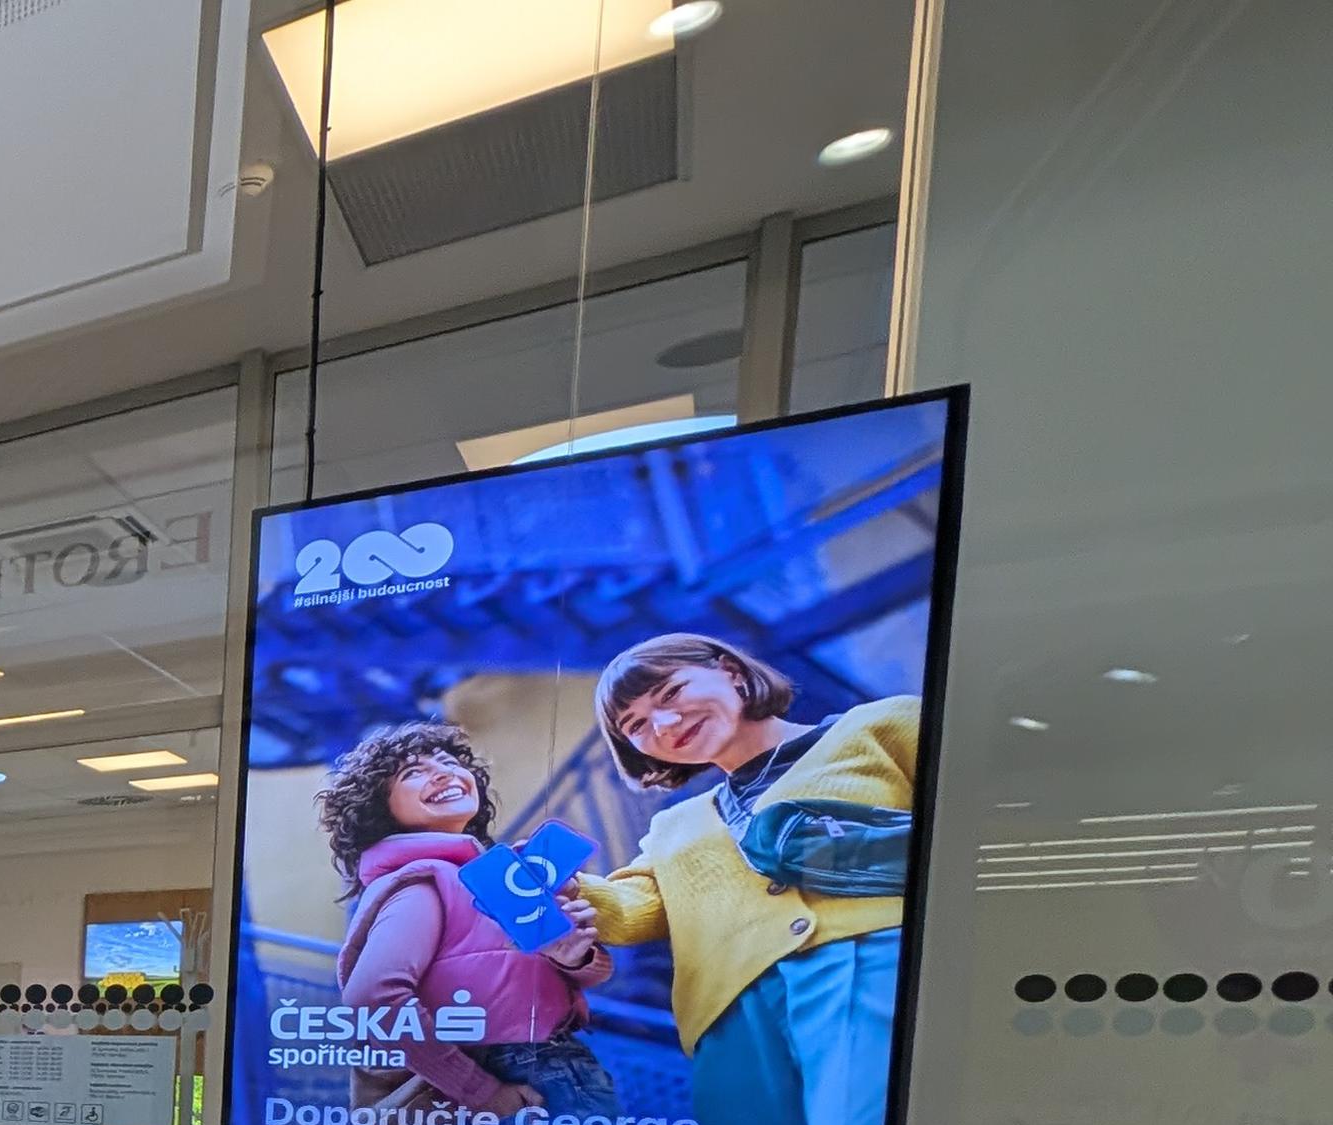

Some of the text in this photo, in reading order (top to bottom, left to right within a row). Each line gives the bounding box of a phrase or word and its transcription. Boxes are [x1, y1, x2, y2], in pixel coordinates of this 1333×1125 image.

[294, 576, 451, 608] #silnější budoucnost
[270, 998, 425, 1042] ČESKÁ
[268, 1045, 406, 1069] spořitelna
